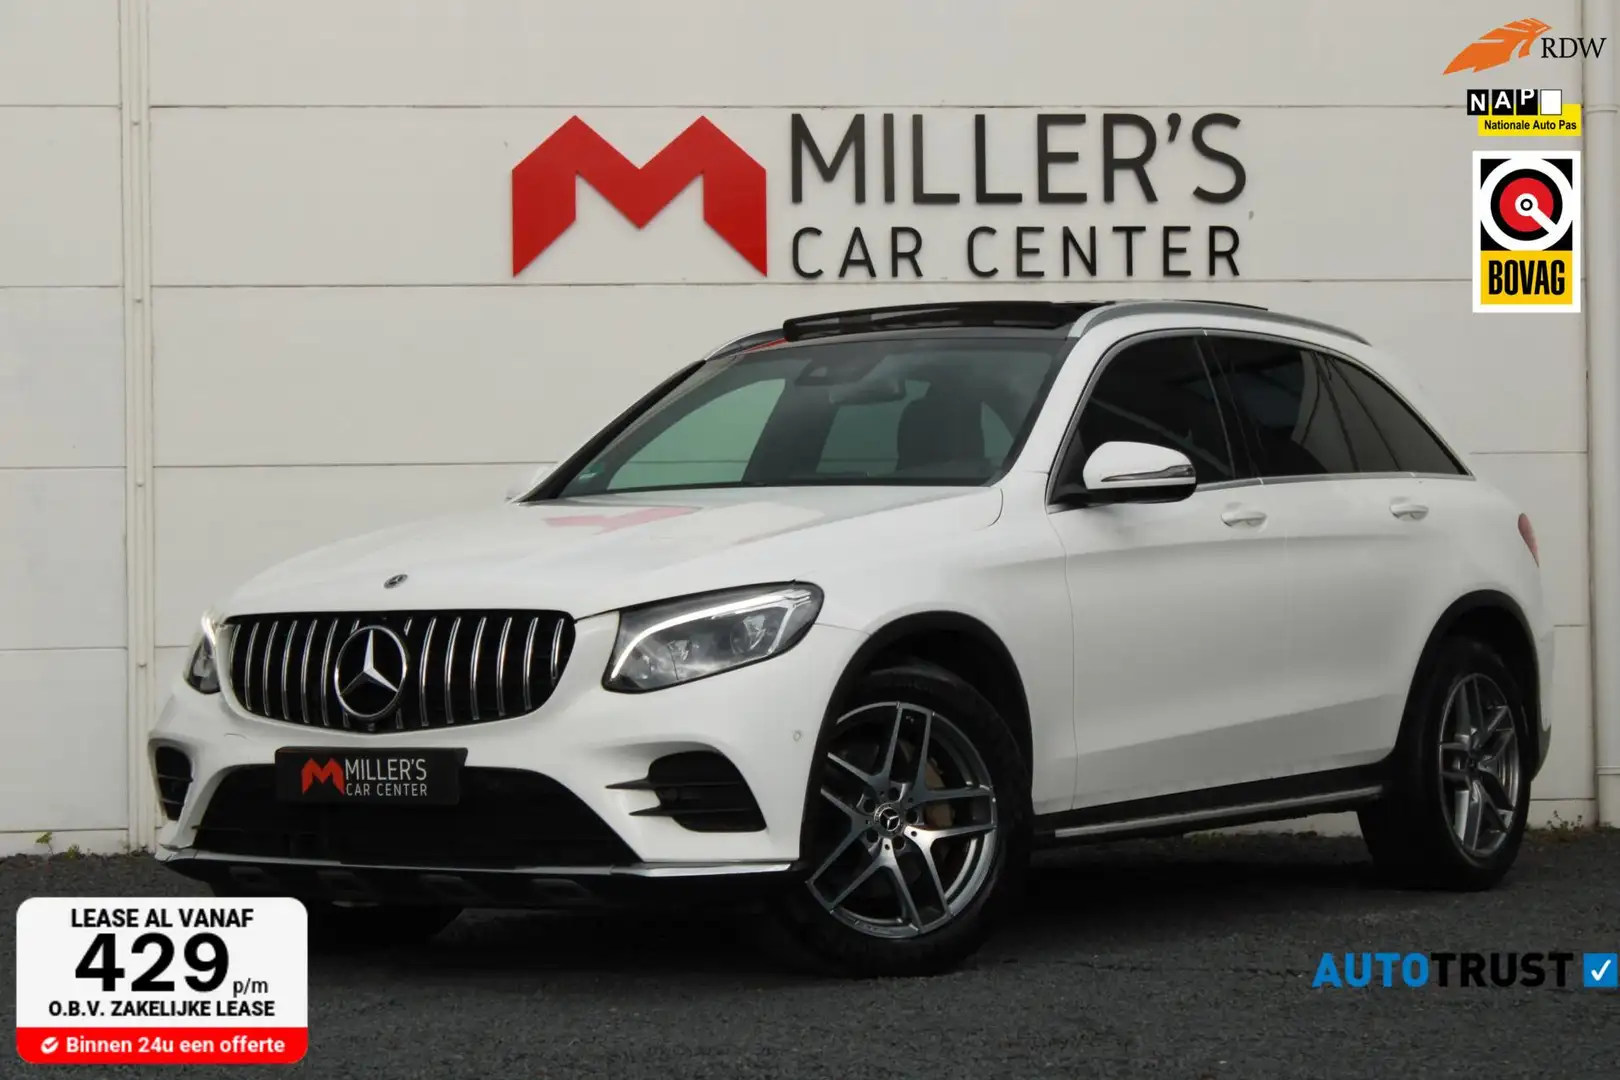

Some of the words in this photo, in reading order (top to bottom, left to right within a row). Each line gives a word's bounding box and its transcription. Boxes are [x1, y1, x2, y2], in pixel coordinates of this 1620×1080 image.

[791, 112, 1248, 204] MILLER'S
[791, 226, 924, 278] CAR
[966, 225, 1241, 277] CENTER
[345, 759, 427, 781] MILLER'S
[346, 784, 370, 796] CAR
[377, 784, 427, 796] CENTER
